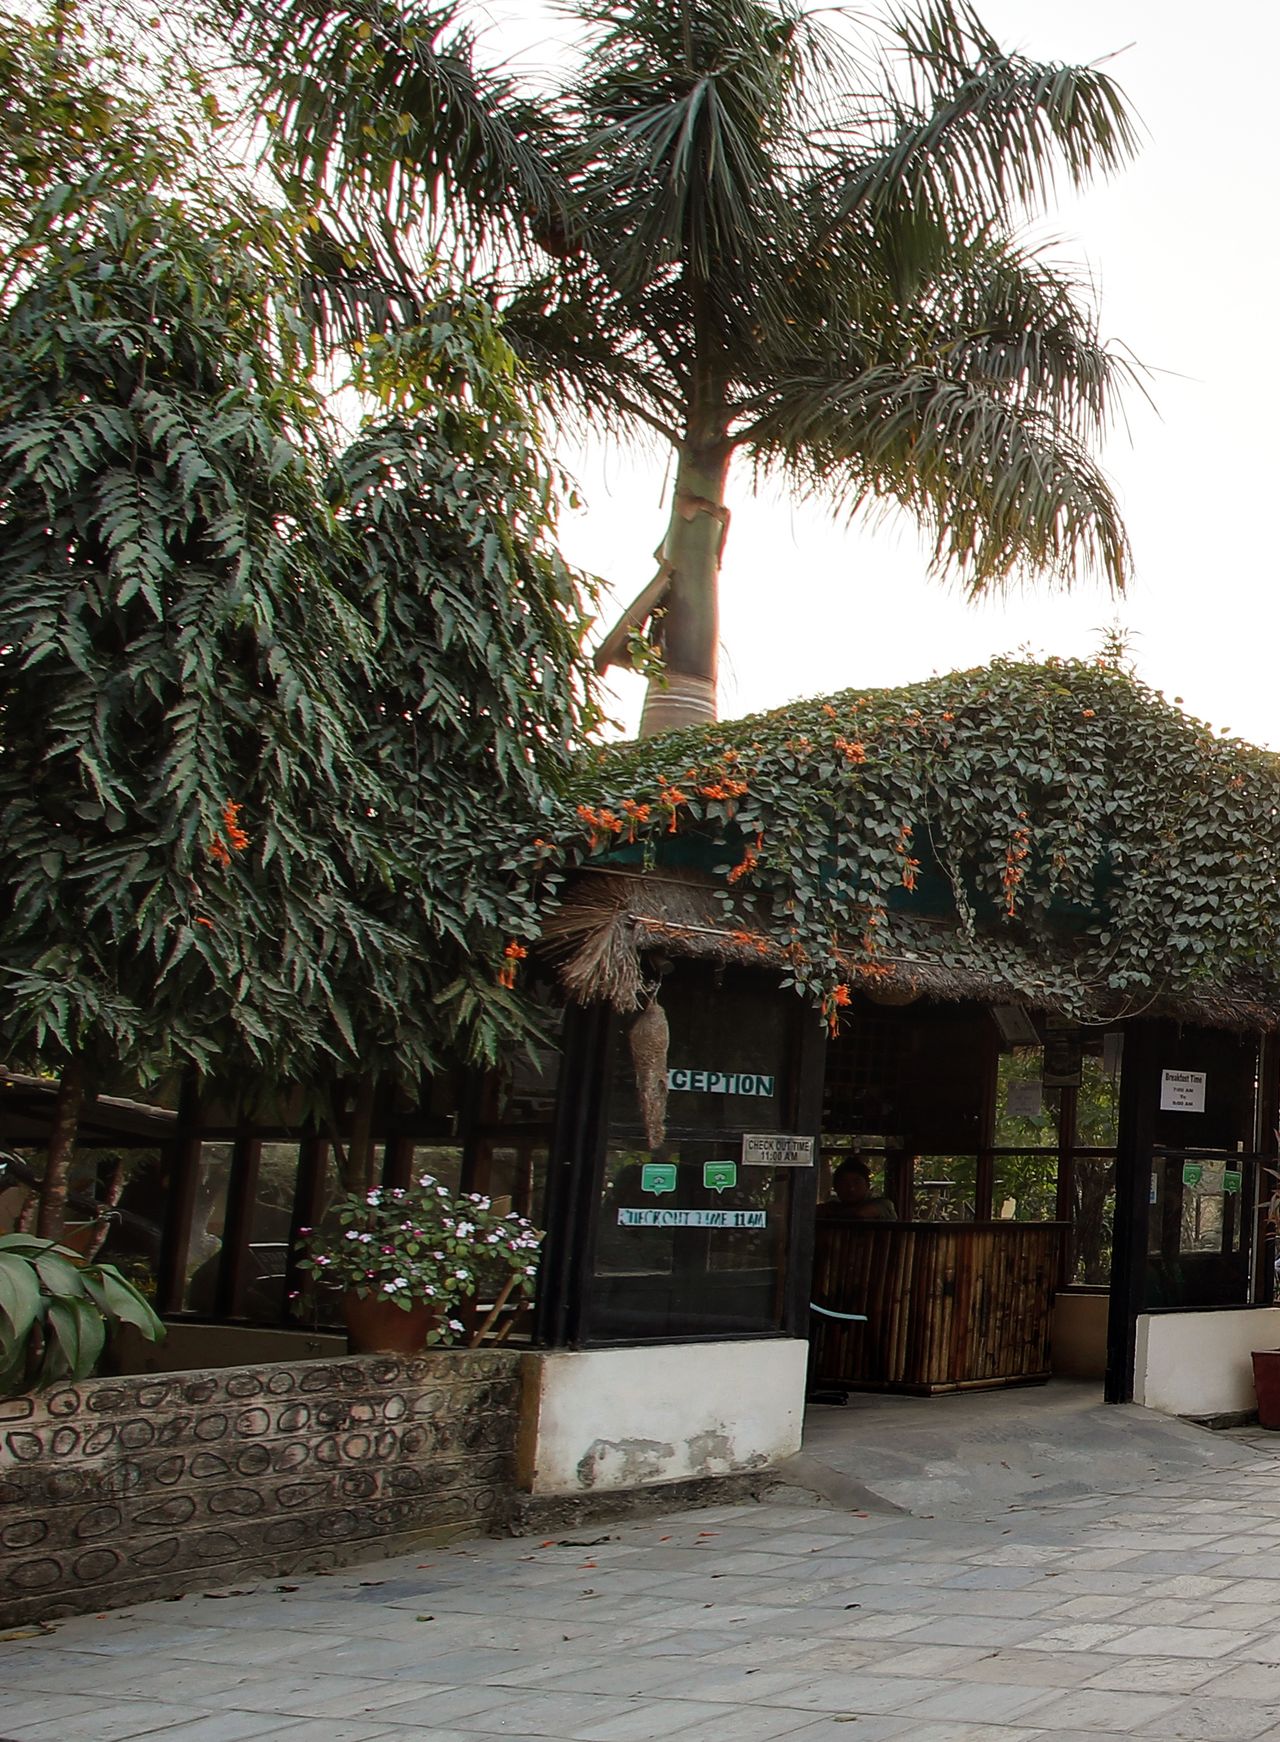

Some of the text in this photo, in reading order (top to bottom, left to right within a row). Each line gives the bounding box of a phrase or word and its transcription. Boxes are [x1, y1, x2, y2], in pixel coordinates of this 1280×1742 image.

[668, 1069, 774, 1096] CEPTION
[1165, 1072, 1202, 1084] Breakfast Time
[748, 1139, 810, 1152] CHECK OUT TIME
[760, 1151, 798, 1161] 11:00 AM
